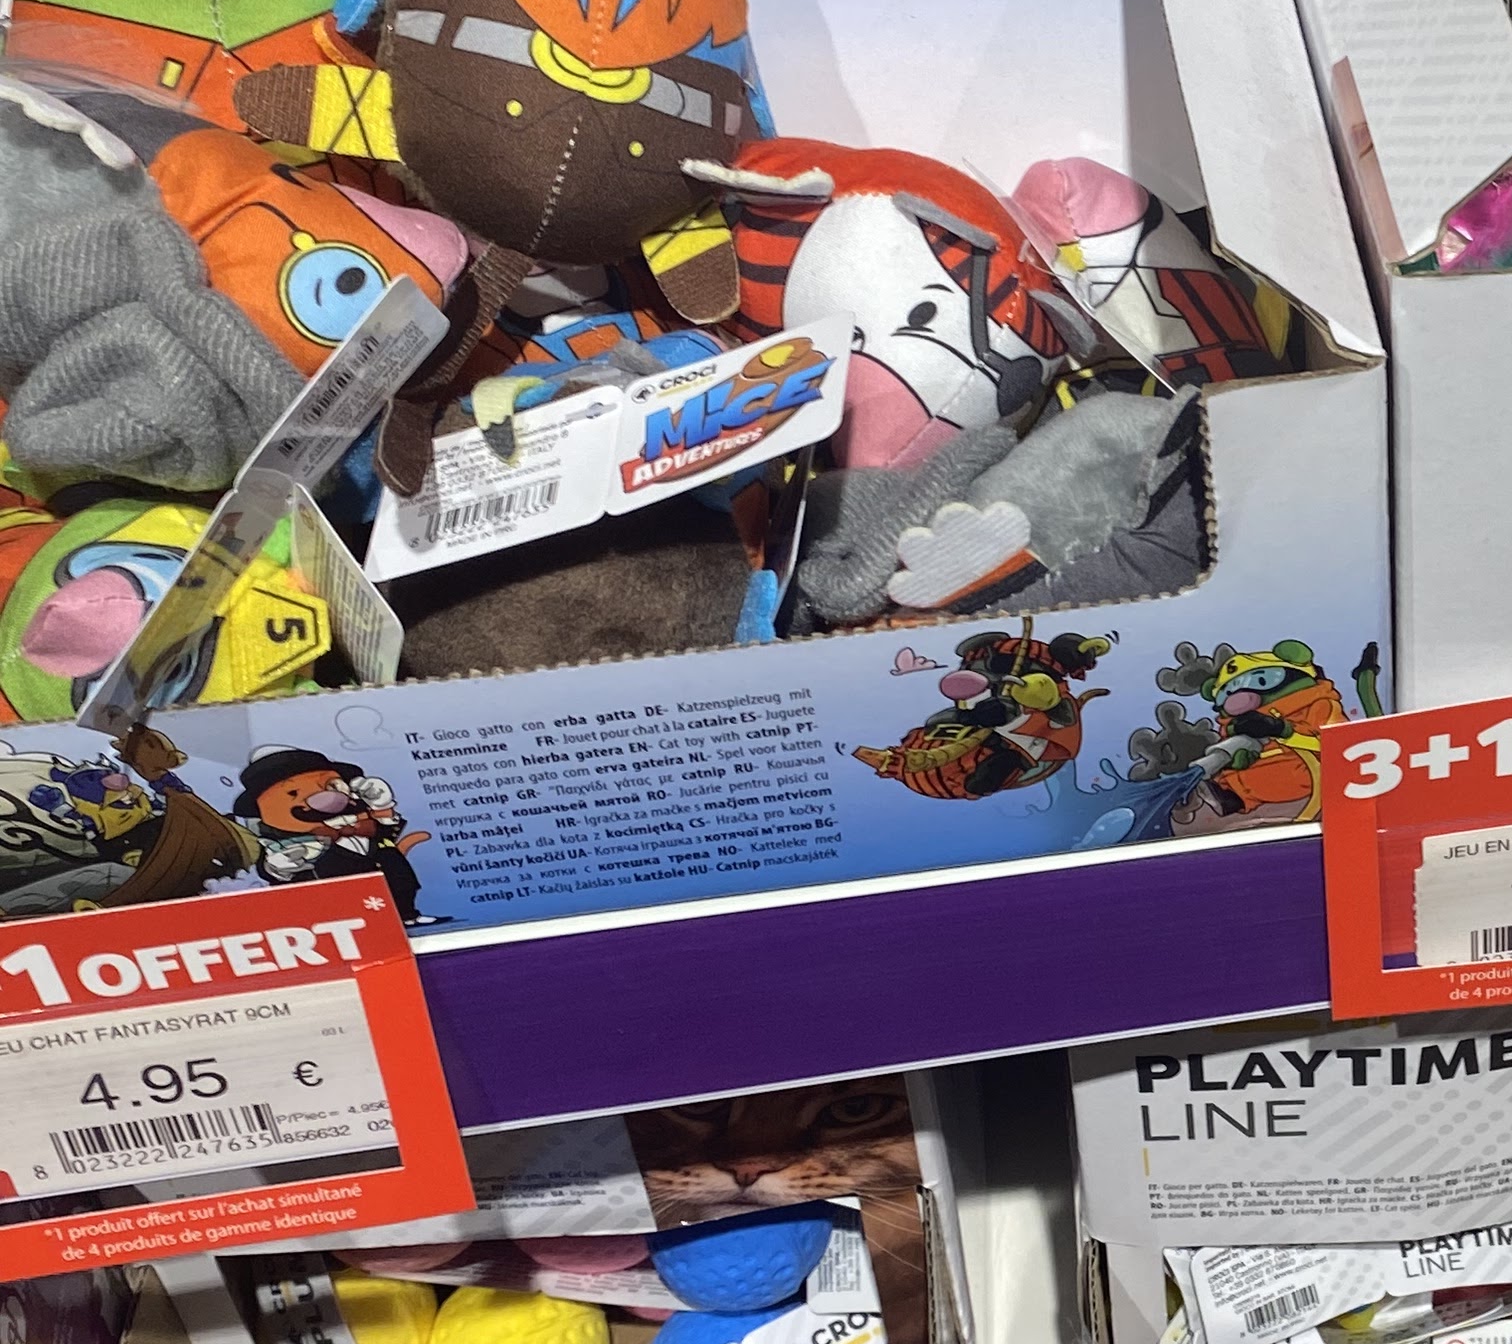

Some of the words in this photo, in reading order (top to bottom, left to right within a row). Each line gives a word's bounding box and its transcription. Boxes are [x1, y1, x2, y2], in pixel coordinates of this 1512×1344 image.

[659, 364, 717, 390] CROCI
[266, 618, 306, 643] 5
[411, 742, 508, 761] Katzenminze
[562, 730, 598, 745] Jouet
[600, 728, 630, 745] pour
[632, 721, 661, 736] chat
[673, 719, 685, 732] la
[687, 714, 738, 730] cataire
[765, 706, 816, 722] Juguete
[433, 728, 471, 742] Gioco
[478, 724, 513, 739] gatto
[521, 720, 546, 732] con
[554, 714, 587, 728] erba
[596, 710, 636, 725] gatta
[677, 692, 782, 714] Katzenspielzeug
[789, 688, 812, 701] mit
[418, 765, 448, 780] para
[452, 762, 489, 777] gatos
[494, 758, 517, 770] con
[521, 751, 570, 767] hierba
[575, 745, 624, 762] gatera
[658, 737, 681, 750] Cat
[685, 733, 705, 748] toy
[711, 730, 740, 744] with
[746, 725, 791, 742] catnip
[423, 778, 491, 795] Brinquedo
[495, 775, 524, 791] para
[529, 770, 558, 787] gato
[563, 768, 591, 780] com
[595, 763, 627, 776] erva
[632, 755, 685, 773] gateira
[717, 746, 745, 762] Spel
[748, 745, 777, 757] voor
[781, 739, 823, 753] katten
[1444, 842, 1480, 861] JEU
[1485, 838, 1511, 855] EN
[1450, 986, 1469, 1001] de
[1473, 984, 1483, 998] 4
[30, 1030, 88, 1051] CHAT
[95, 1008, 238, 1042] FANTASYRAT
[245, 1002, 291, 1023] 9CM
[79, 1057, 229, 1111] 4.95
[292, 1060, 324, 1087] €
[1141, 1099, 1309, 1143] LINE
[61, 1245, 85, 1262] de
[88, 1242, 101, 1258] 4
[104, 1228, 177, 1258] produits
[180, 1226, 202, 1244] de
[206, 1219, 270, 1243] gamme
[273, 1205, 357, 1234] identique
[64, 1216, 133, 1244] produit
[138, 1207, 186, 1231] offert
[190, 1206, 213, 1222] sur
[217, 1194, 276, 1219] l'achat
[279, 1182, 362, 1210] simultané
[1402, 1252, 1465, 1278] LINE
